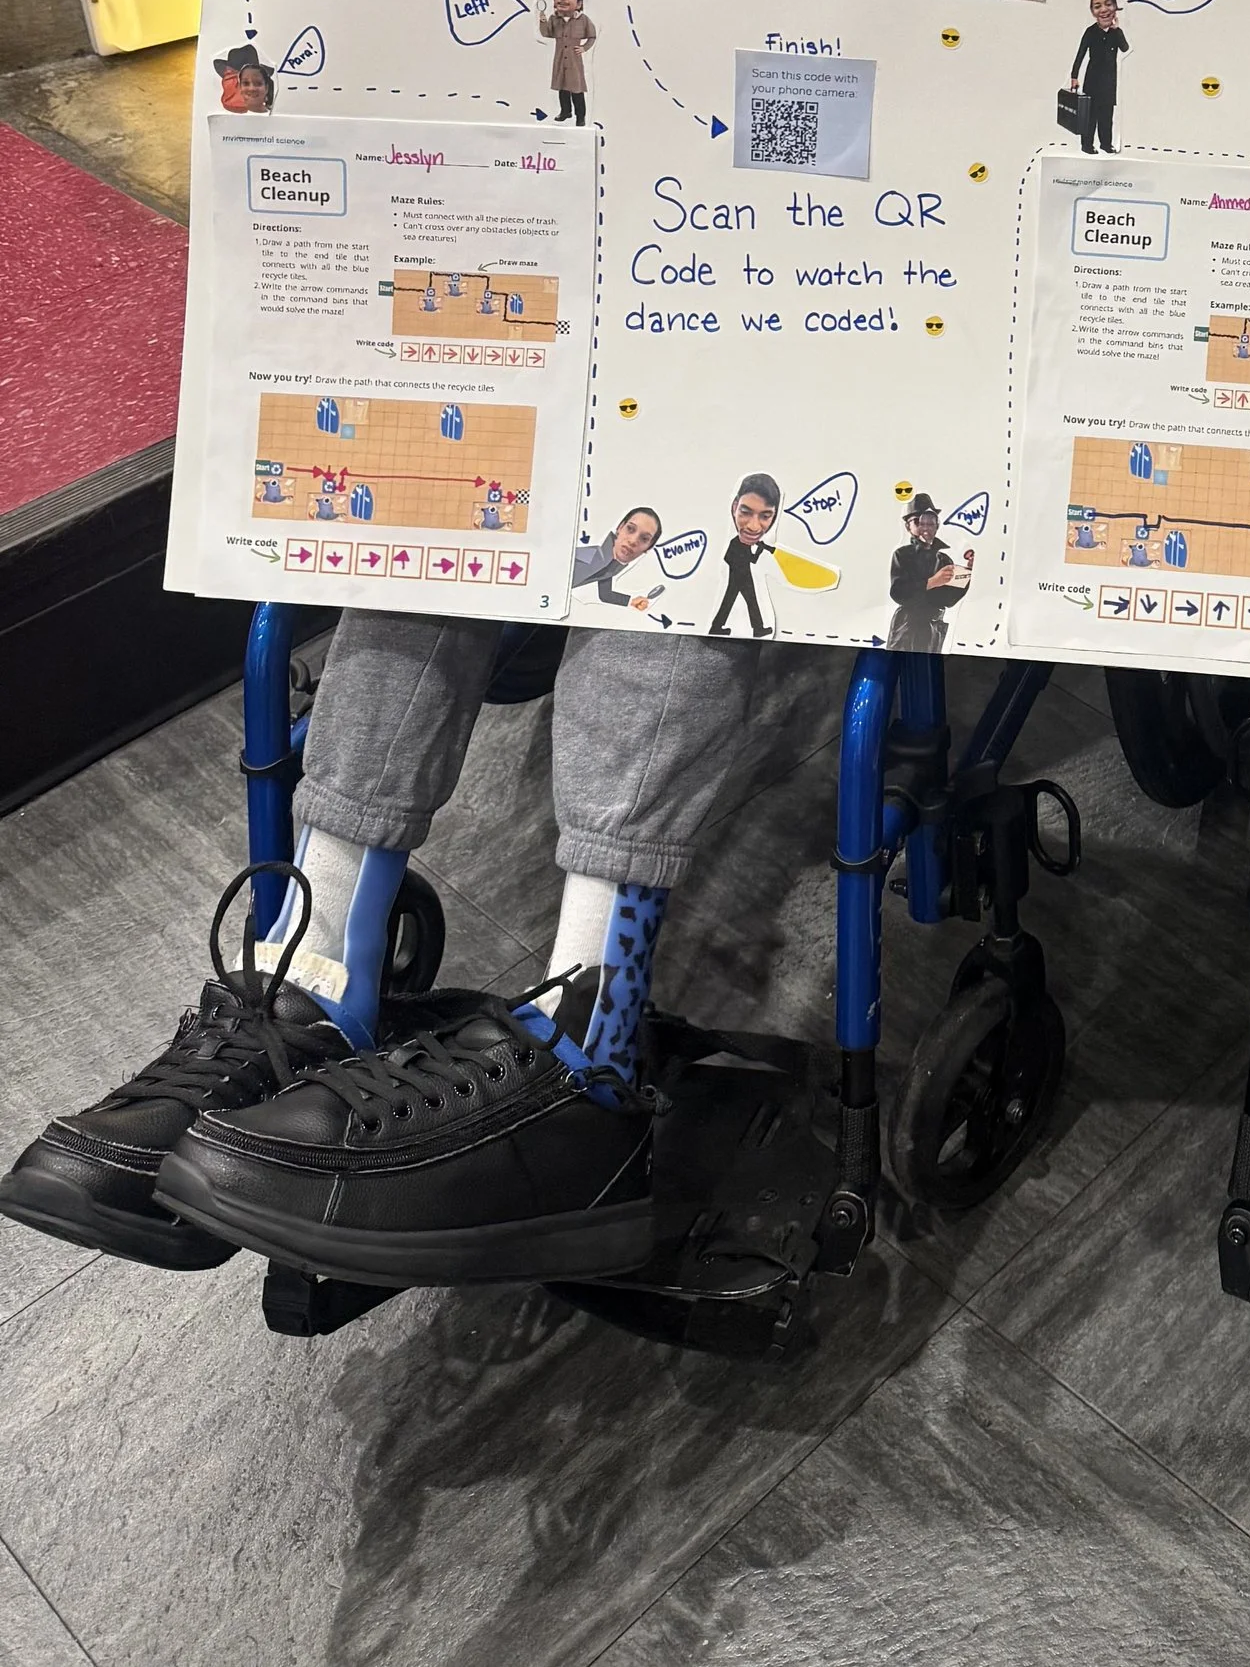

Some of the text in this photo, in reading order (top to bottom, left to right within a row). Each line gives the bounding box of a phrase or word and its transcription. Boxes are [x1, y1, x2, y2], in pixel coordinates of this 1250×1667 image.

[751, 68, 858, 84] Scan this code with
[751, 85, 858, 98] your phone camera:
[356, 153, 384, 162] Name:
[385, 144, 444, 173] Jesslyn
[494, 159, 518, 168] Date:
[521, 152, 556, 173] 12/10
[260, 168, 311, 184] Beach
[260, 186, 330, 206] Cleanup
[390, 195, 445, 206] Maze Rules:
[1180, 198, 1208, 207] Name:
[653, 176, 946, 233] Scan the QR
[1085, 210, 1135, 227] Beach
[252, 222, 302, 233] Directions:
[1084, 228, 1152, 250] Cleanup
[1210, 240, 1234, 250] Maze
[393, 254, 436, 266] Example:
[631, 244, 958, 287] Code to watch the
[1073, 265, 1122, 276] Directions:
[1210, 300, 1250, 312] Example:
[625, 302, 898, 334] dance we coded!
[249, 372, 495, 393] Now you try! Draw the path that connects the recycle tiles
[1063, 415, 1086, 424] Now
[1088, 418, 1106, 427] you
[1108, 419, 1126, 429] try!
[802, 490, 842, 514] stop!
[226, 536, 278, 548] Write code
[1038, 582, 1091, 594] Write code
[539, 594, 550, 608] 3
